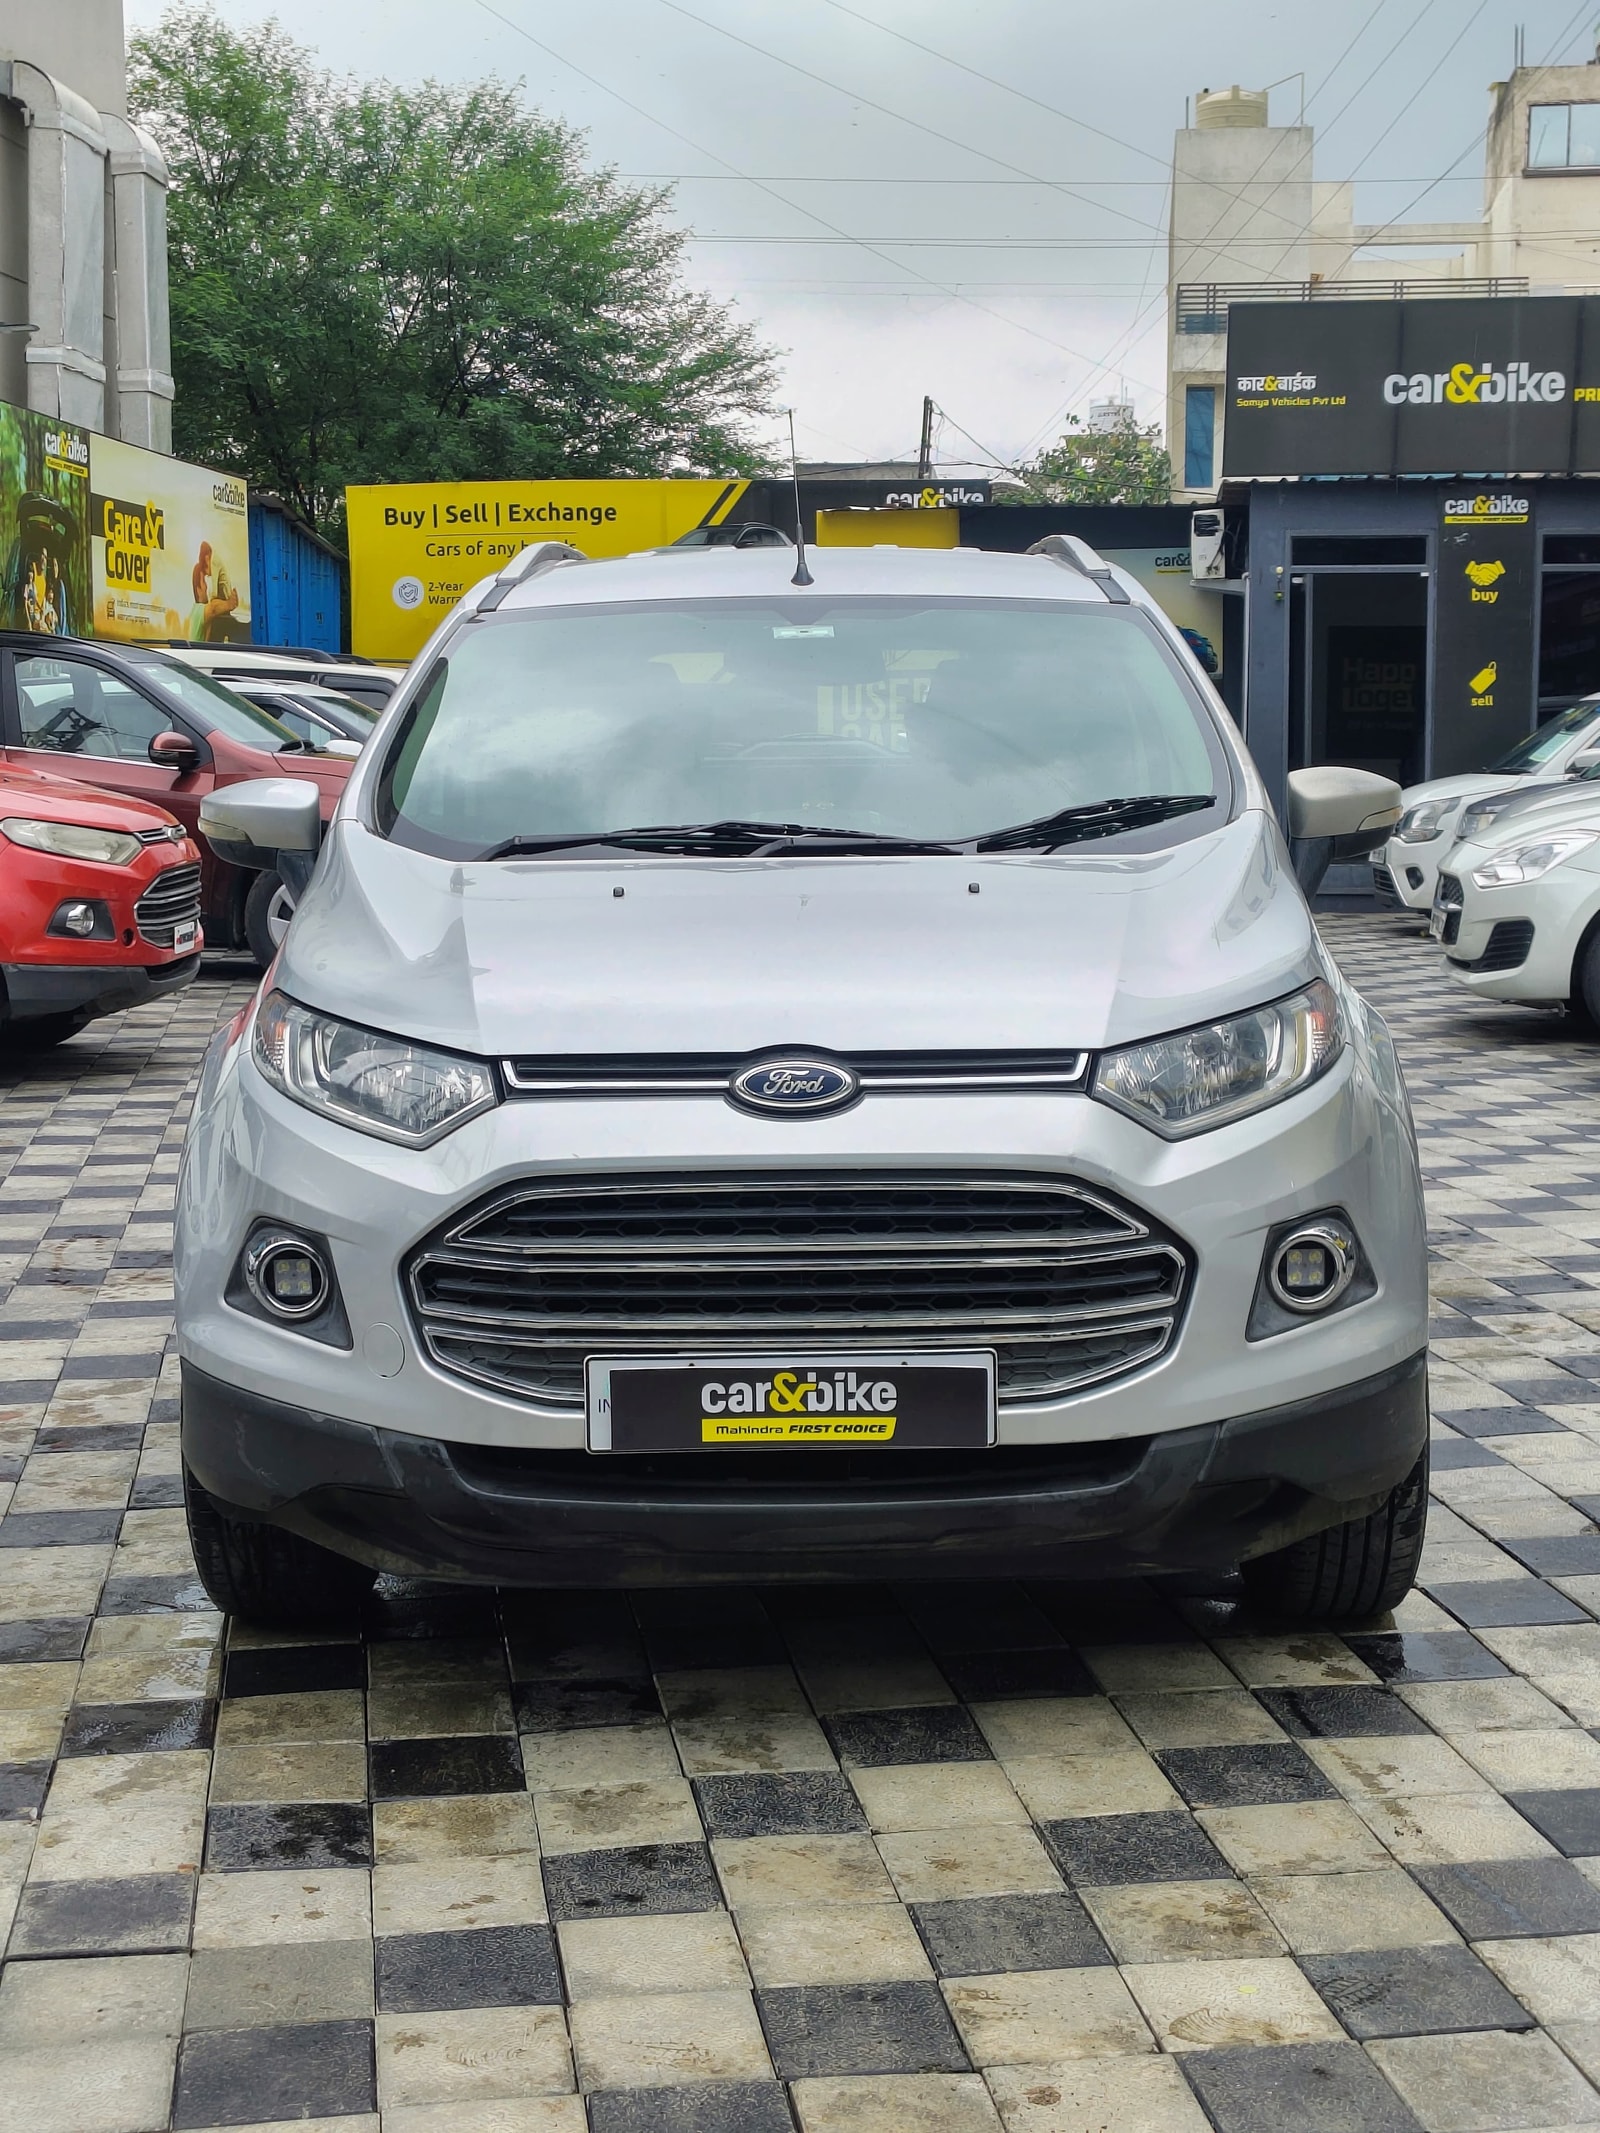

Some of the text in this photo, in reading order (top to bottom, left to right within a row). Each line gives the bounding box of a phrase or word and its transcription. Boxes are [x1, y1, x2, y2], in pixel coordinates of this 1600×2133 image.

[1384, 362, 1600, 404] car&bike PR
[1272, 396, 1311, 406] Vehicles
[1331, 396, 1347, 406] Ltd
[1445, 495, 1528, 514] car&bike
[104, 500, 164, 549] Care &
[384, 507, 426, 529] Buy
[445, 503, 488, 524] Sell
[508, 502, 617, 525] Exchange
[425, 543, 461, 556] Cars
[466, 541, 483, 556] of
[488, 543, 516, 558] any
[106, 540, 150, 584] Cover
[428, 582, 464, 592] 2-Year
[1471, 588, 1498, 604] buy
[1471, 695, 1493, 706] sell
[763, 1069, 825, 1094] Ford
[701, 1372, 898, 1413] car&bike
[716, 1424, 887, 1435] Mahindra FIRST CHOICE
